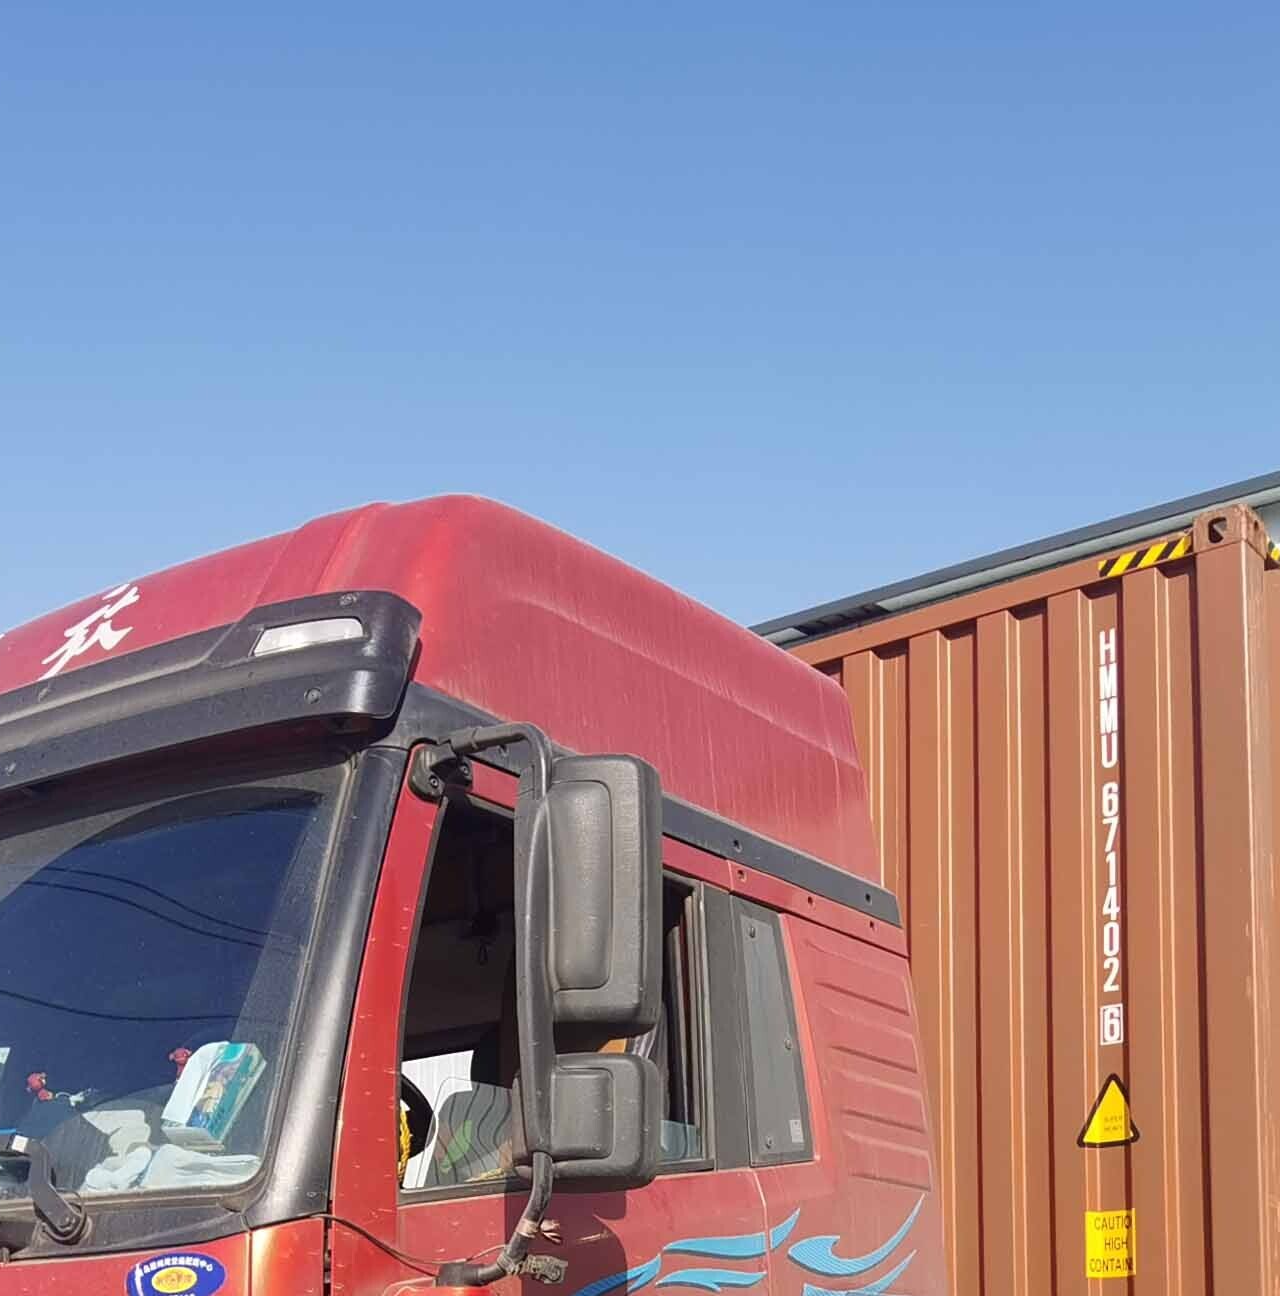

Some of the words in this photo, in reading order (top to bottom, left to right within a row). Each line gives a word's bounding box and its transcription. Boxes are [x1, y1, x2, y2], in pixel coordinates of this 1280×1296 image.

[1099, 627, 1118, 768] HMMU
[1102, 782, 1120, 992] 671402
[1094, 1215, 1132, 1230] CAUTIO
[1089, 1257, 1133, 1272] CONTAIN
